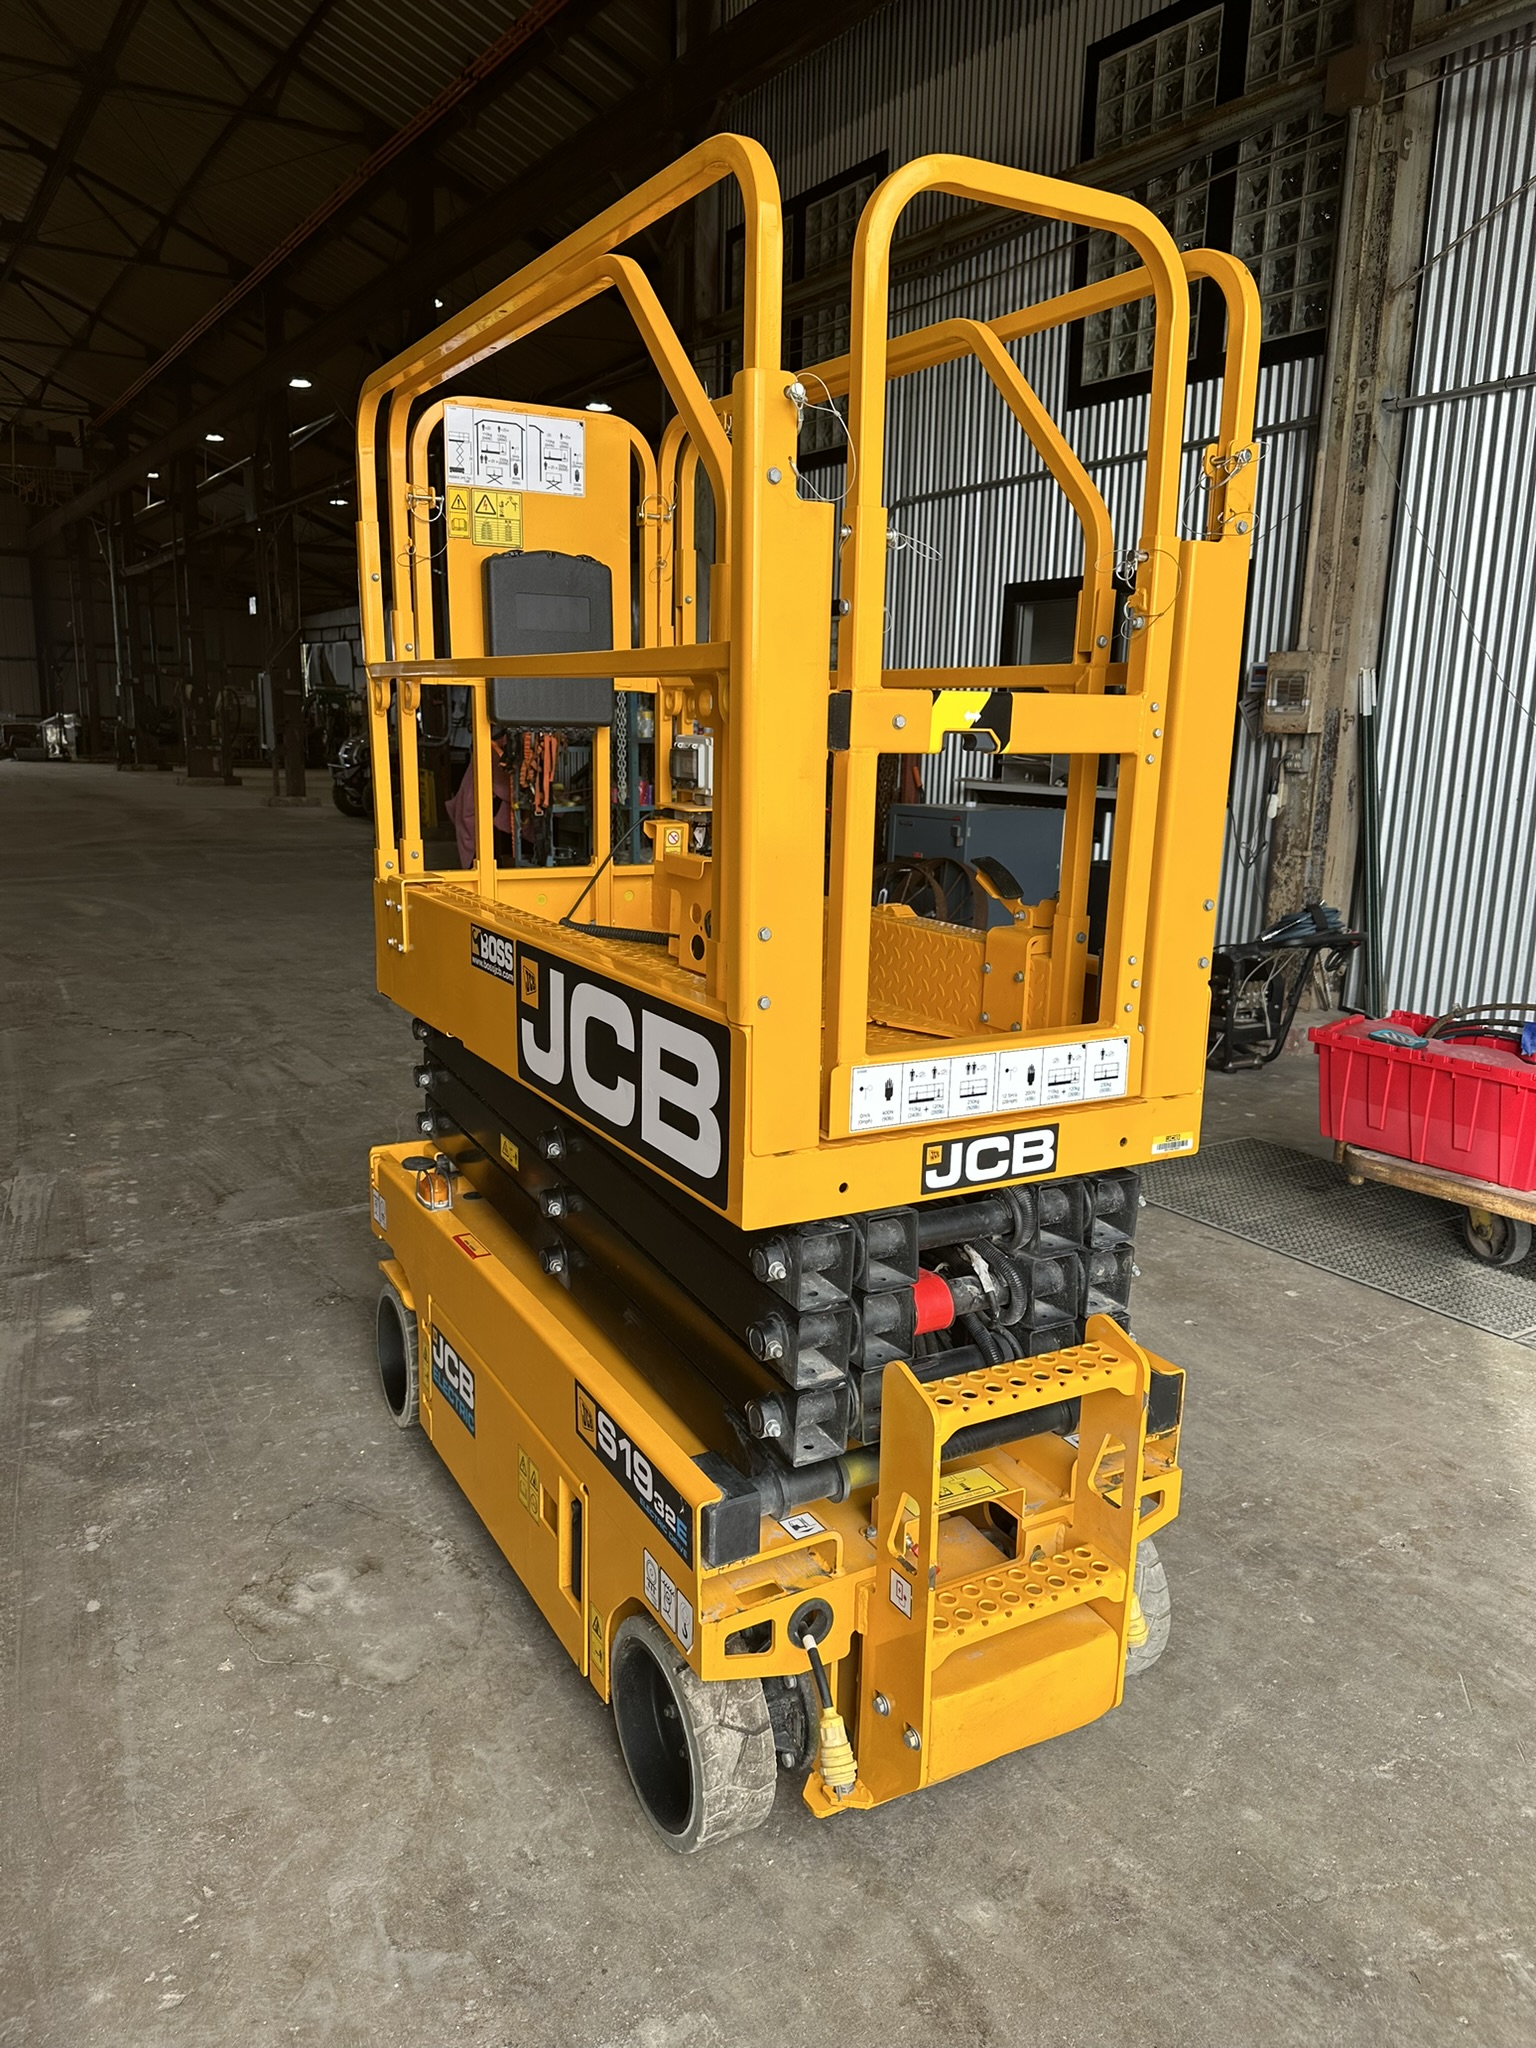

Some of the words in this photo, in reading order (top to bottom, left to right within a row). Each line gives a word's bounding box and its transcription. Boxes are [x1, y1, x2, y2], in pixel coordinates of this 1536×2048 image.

[472, 956, 514, 982] www.bossjcb.com
[481, 933, 513, 971] BOSS
[521, 967, 722, 1179] JCB
[925, 1129, 1055, 1189] JCB
[432, 1335, 475, 1410] JCB
[432, 1364, 475, 1433] ELECTRIC
[639, 1496, 668, 1535] ELECTRIC
[668, 1531, 688, 1559] DRIVE
